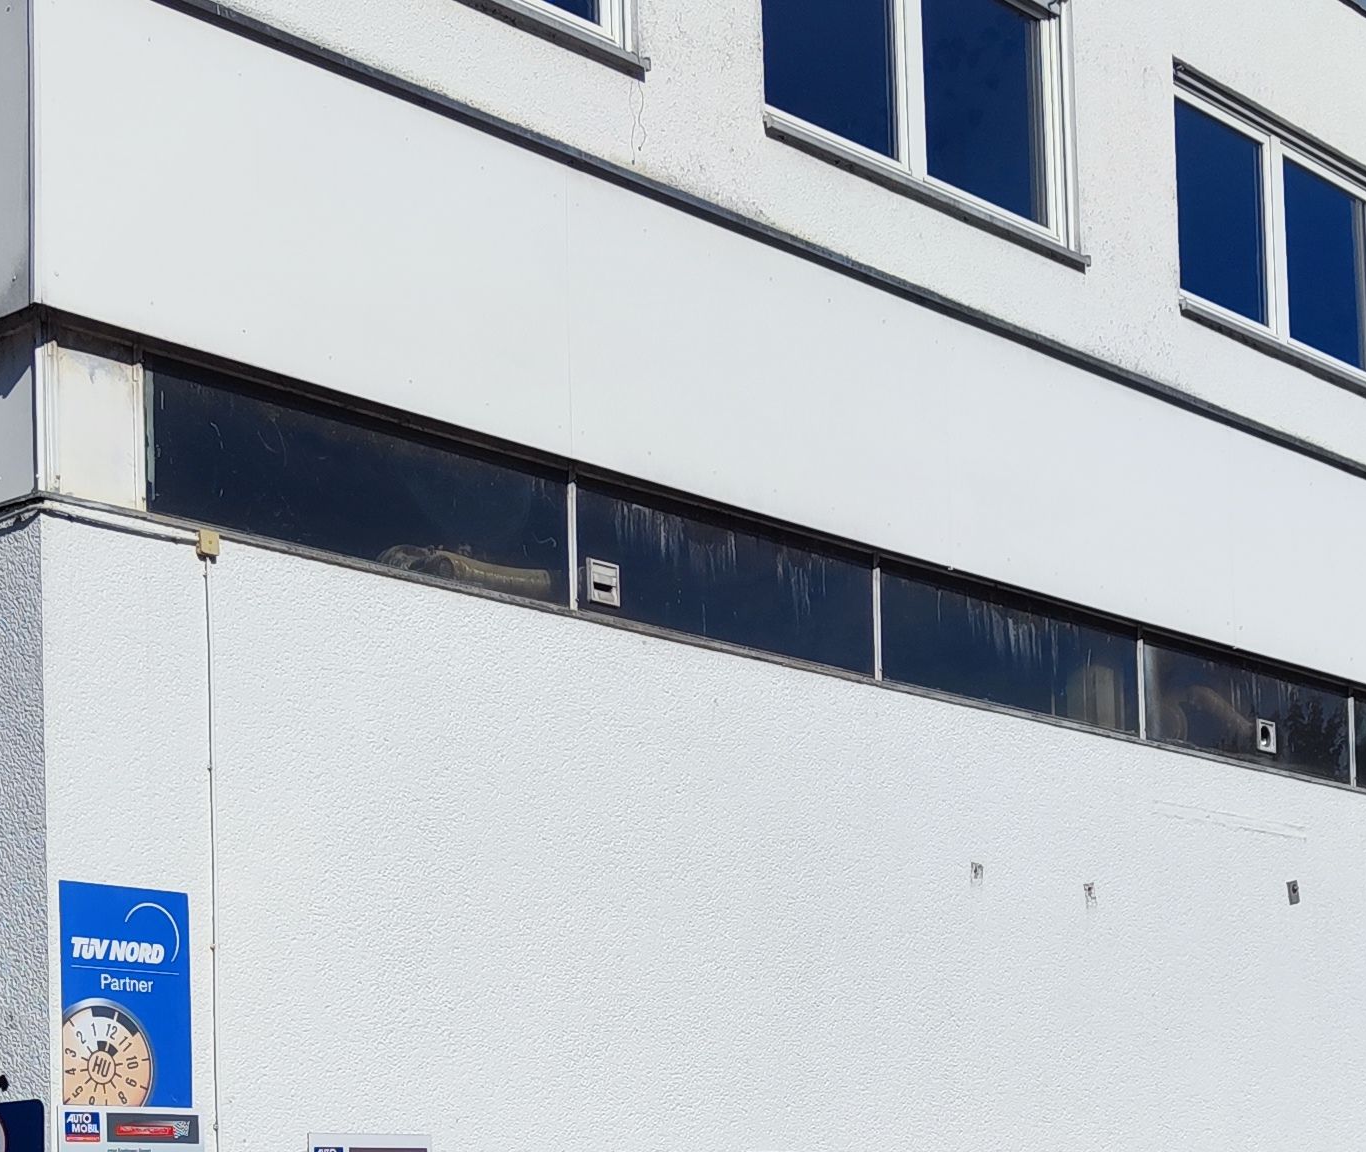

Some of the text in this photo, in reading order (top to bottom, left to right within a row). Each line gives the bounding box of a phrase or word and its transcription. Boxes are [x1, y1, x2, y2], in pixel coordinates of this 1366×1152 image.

[71, 936, 165, 964] TÜV NORD
[100, 973, 154, 993] Partner
[105, 1024, 118, 1040] 12
[91, 1055, 112, 1077] HU
[67, 1113, 92, 1124] AUTO
[71, 1123, 99, 1134] MOBIL
